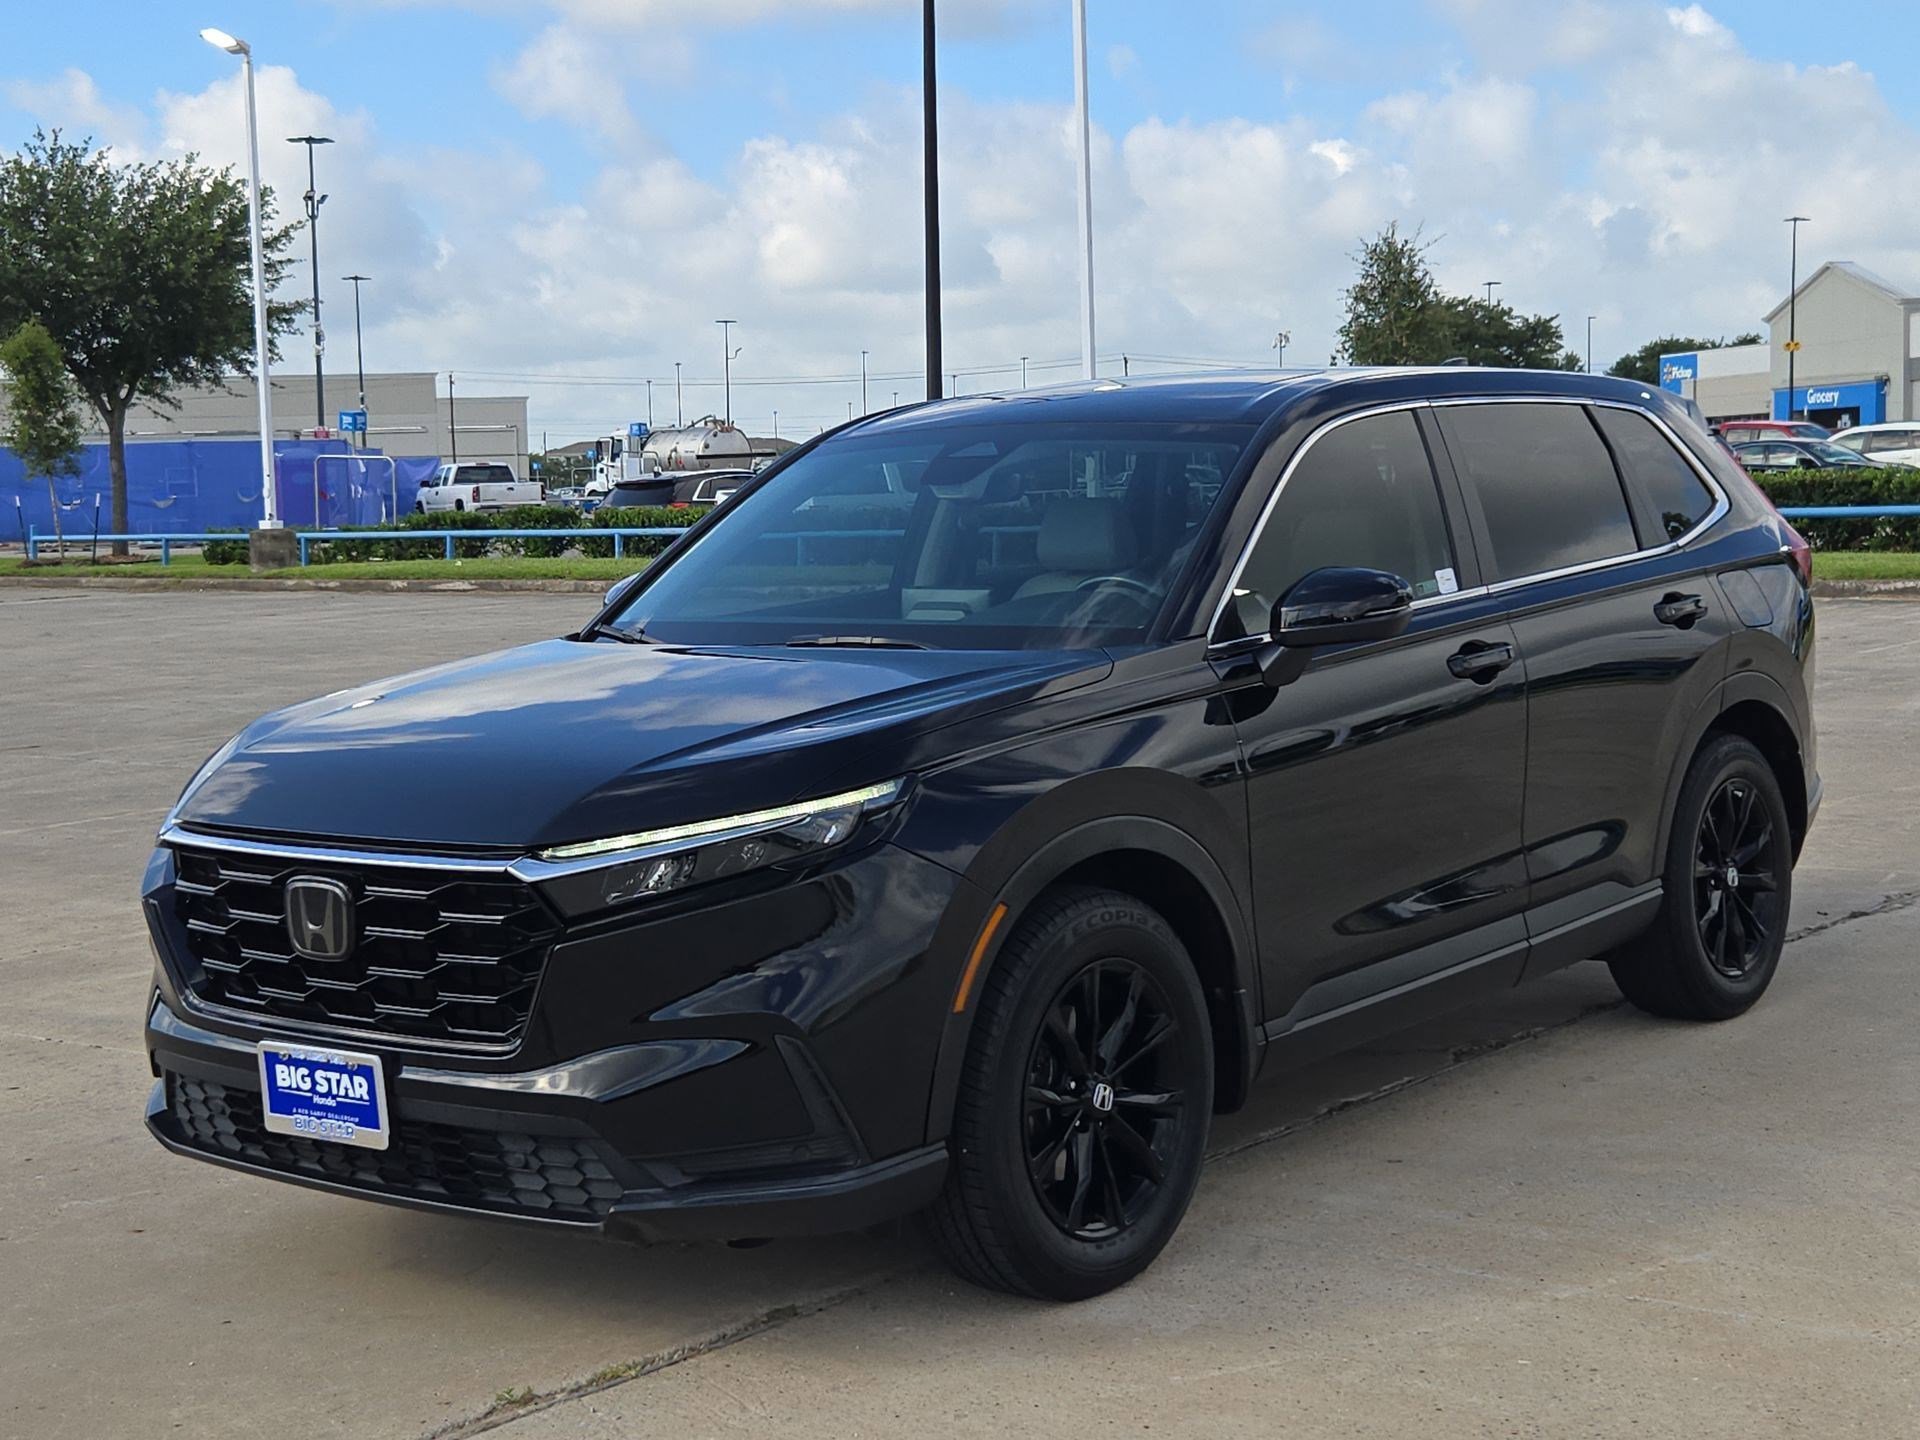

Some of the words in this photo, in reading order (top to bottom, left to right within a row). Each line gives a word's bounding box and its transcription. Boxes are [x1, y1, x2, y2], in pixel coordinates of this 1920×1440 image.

[1806, 387, 1840, 407] Grocery
[275, 1064, 312, 1091] BIG
[314, 1069, 370, 1100] STAR
[313, 1094, 337, 1107] Honda
